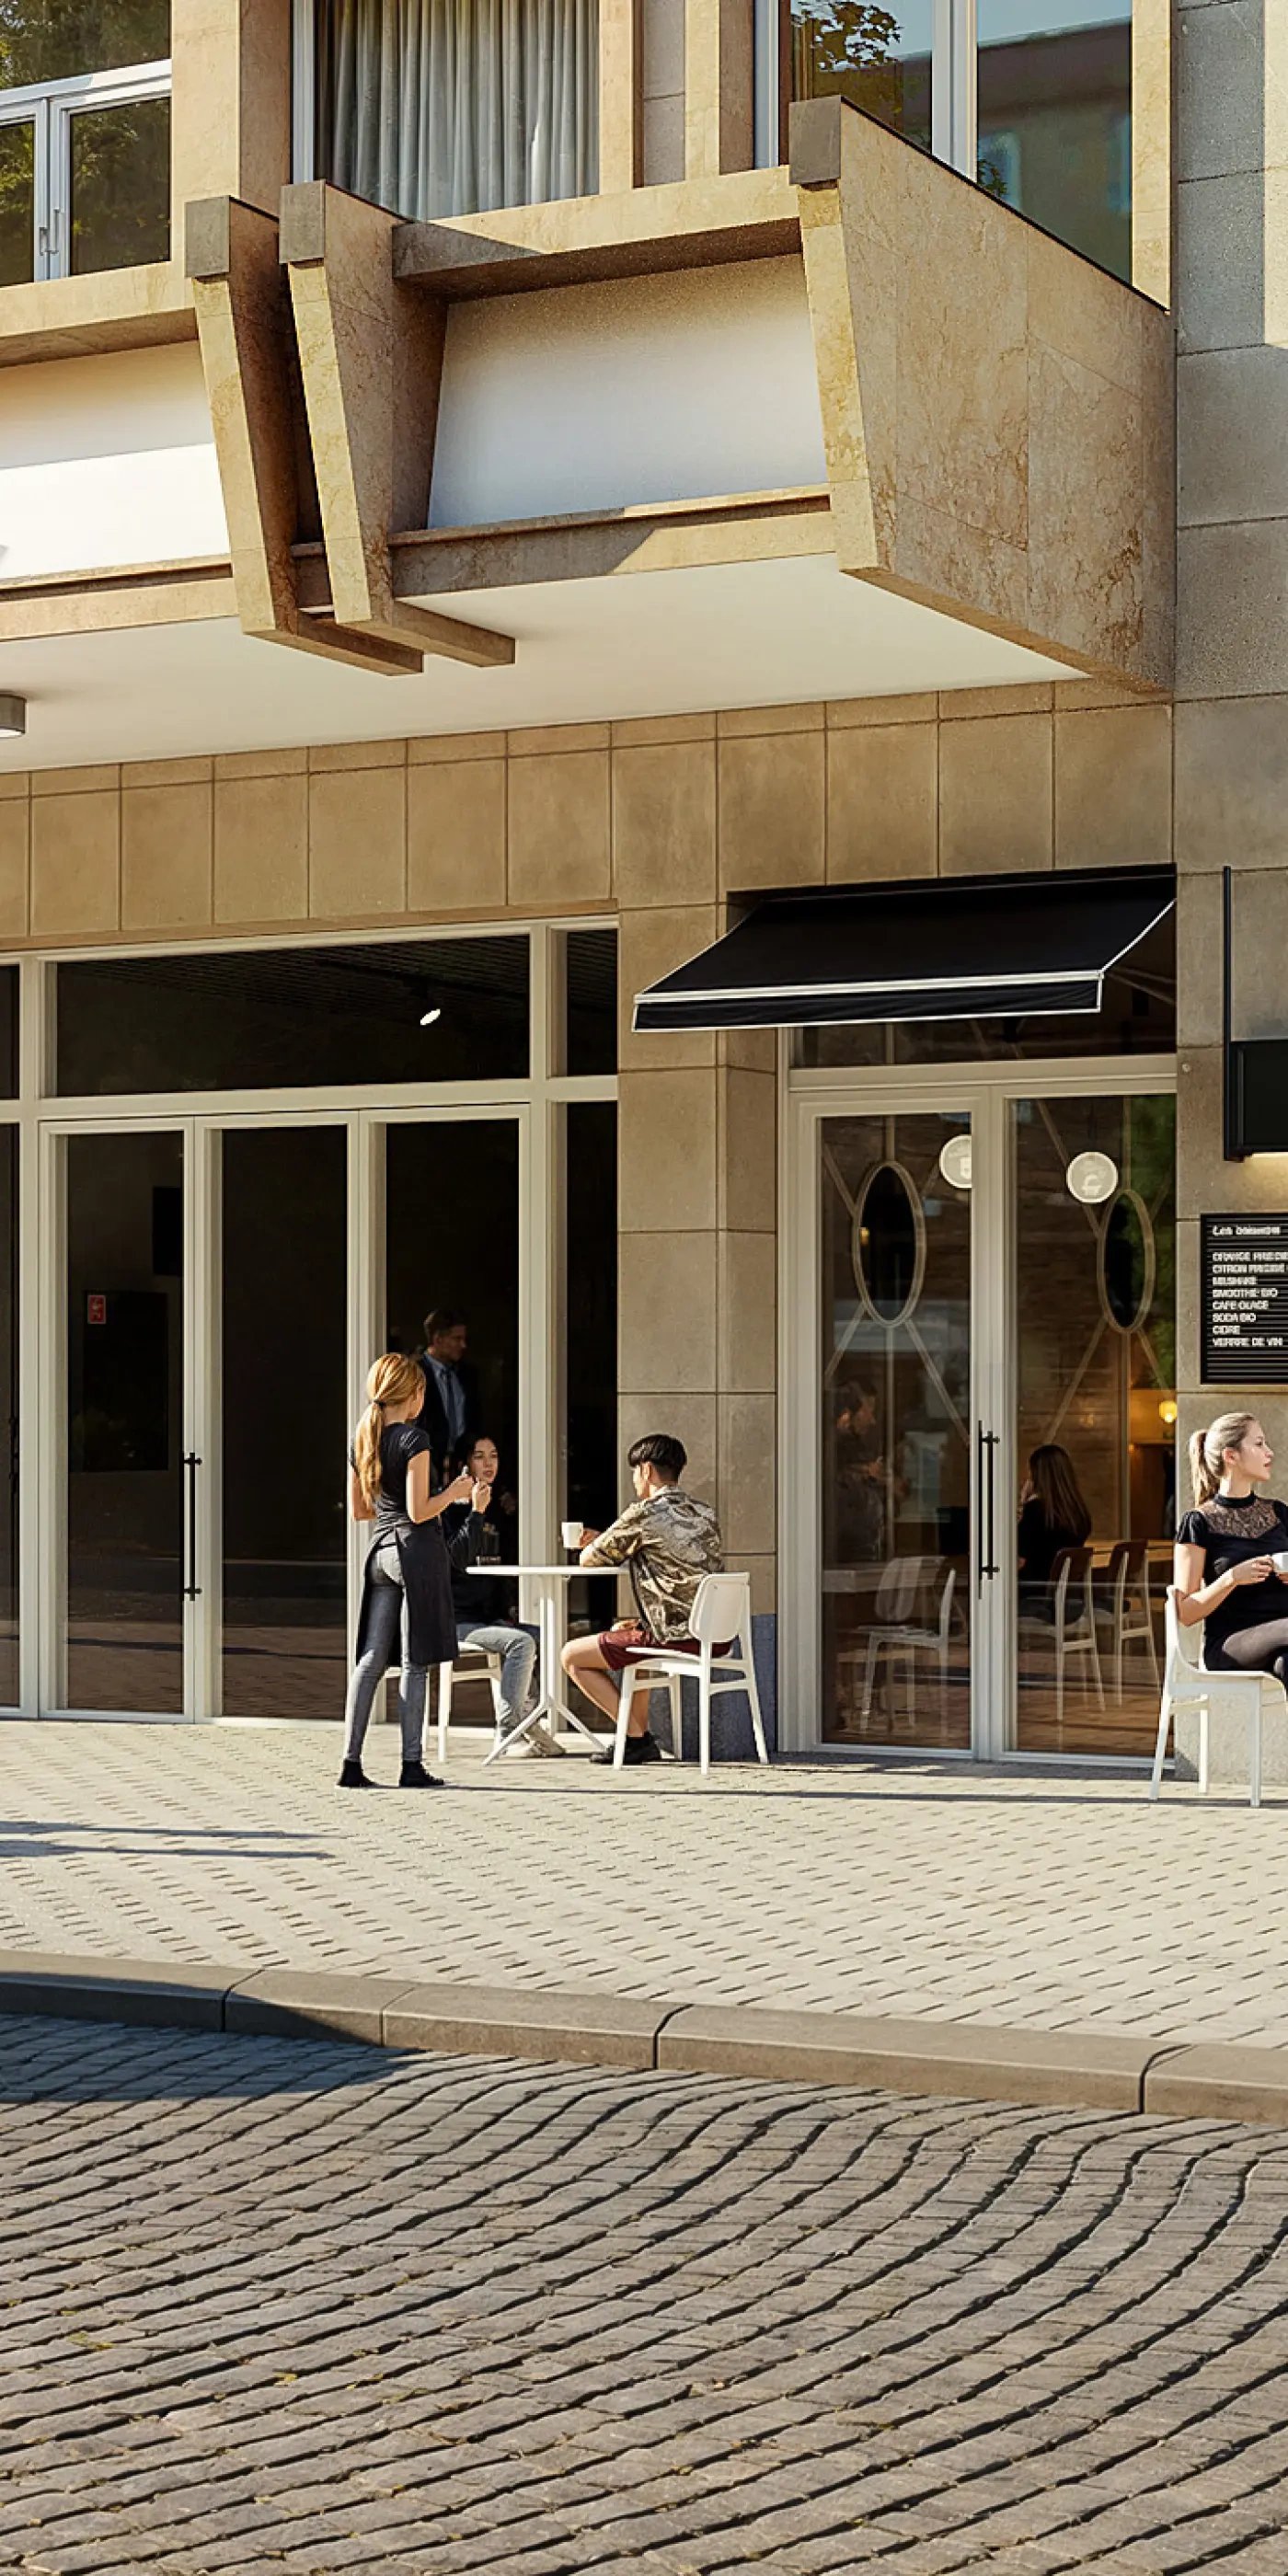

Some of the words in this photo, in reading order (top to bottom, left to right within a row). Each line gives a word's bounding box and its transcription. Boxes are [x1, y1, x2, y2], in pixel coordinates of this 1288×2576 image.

[1213, 1312, 1238, 1323] SODA
[1213, 1325, 1241, 1335] CIDRE
[1251, 1337, 1265, 1348] DE
[1266, 1337, 1283, 1348] VIN
